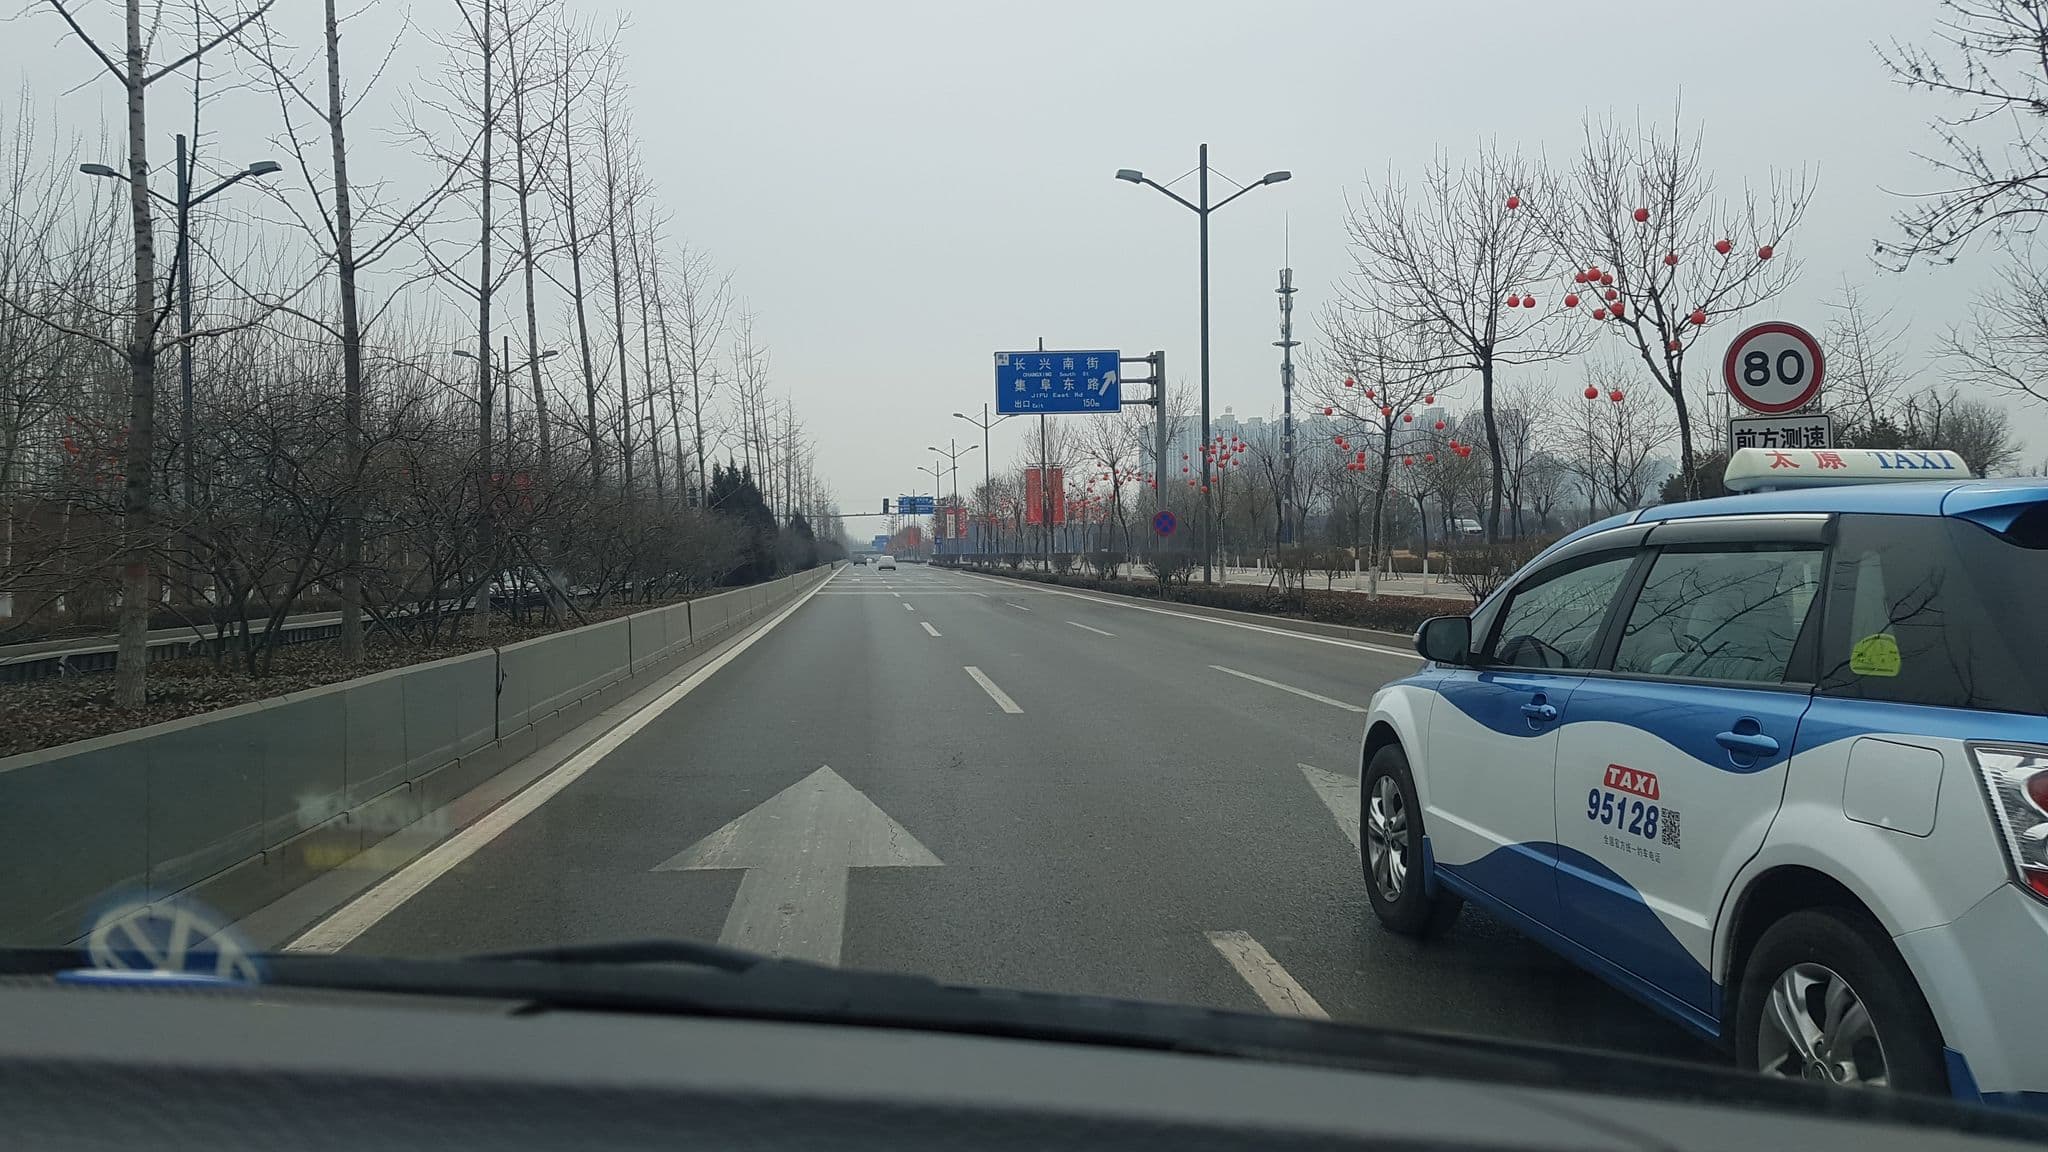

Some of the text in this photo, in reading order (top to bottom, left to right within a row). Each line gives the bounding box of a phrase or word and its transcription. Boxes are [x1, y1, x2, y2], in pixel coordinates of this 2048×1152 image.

[1013, 356, 1098, 370] 长兴南街
[1744, 349, 1804, 386] 80
[1014, 378, 1100, 392] 集阜东路
[1052, 391, 1070, 399] East
[1082, 398, 1101, 408] 150m
[1014, 400, 1030, 408] 出口
[1735, 426, 1825, 448] 前方测速
[1765, 450, 1955, 470] 太原 TAXI
[1608, 767, 1656, 796] TAXI
[1587, 788, 1659, 839] 95128
